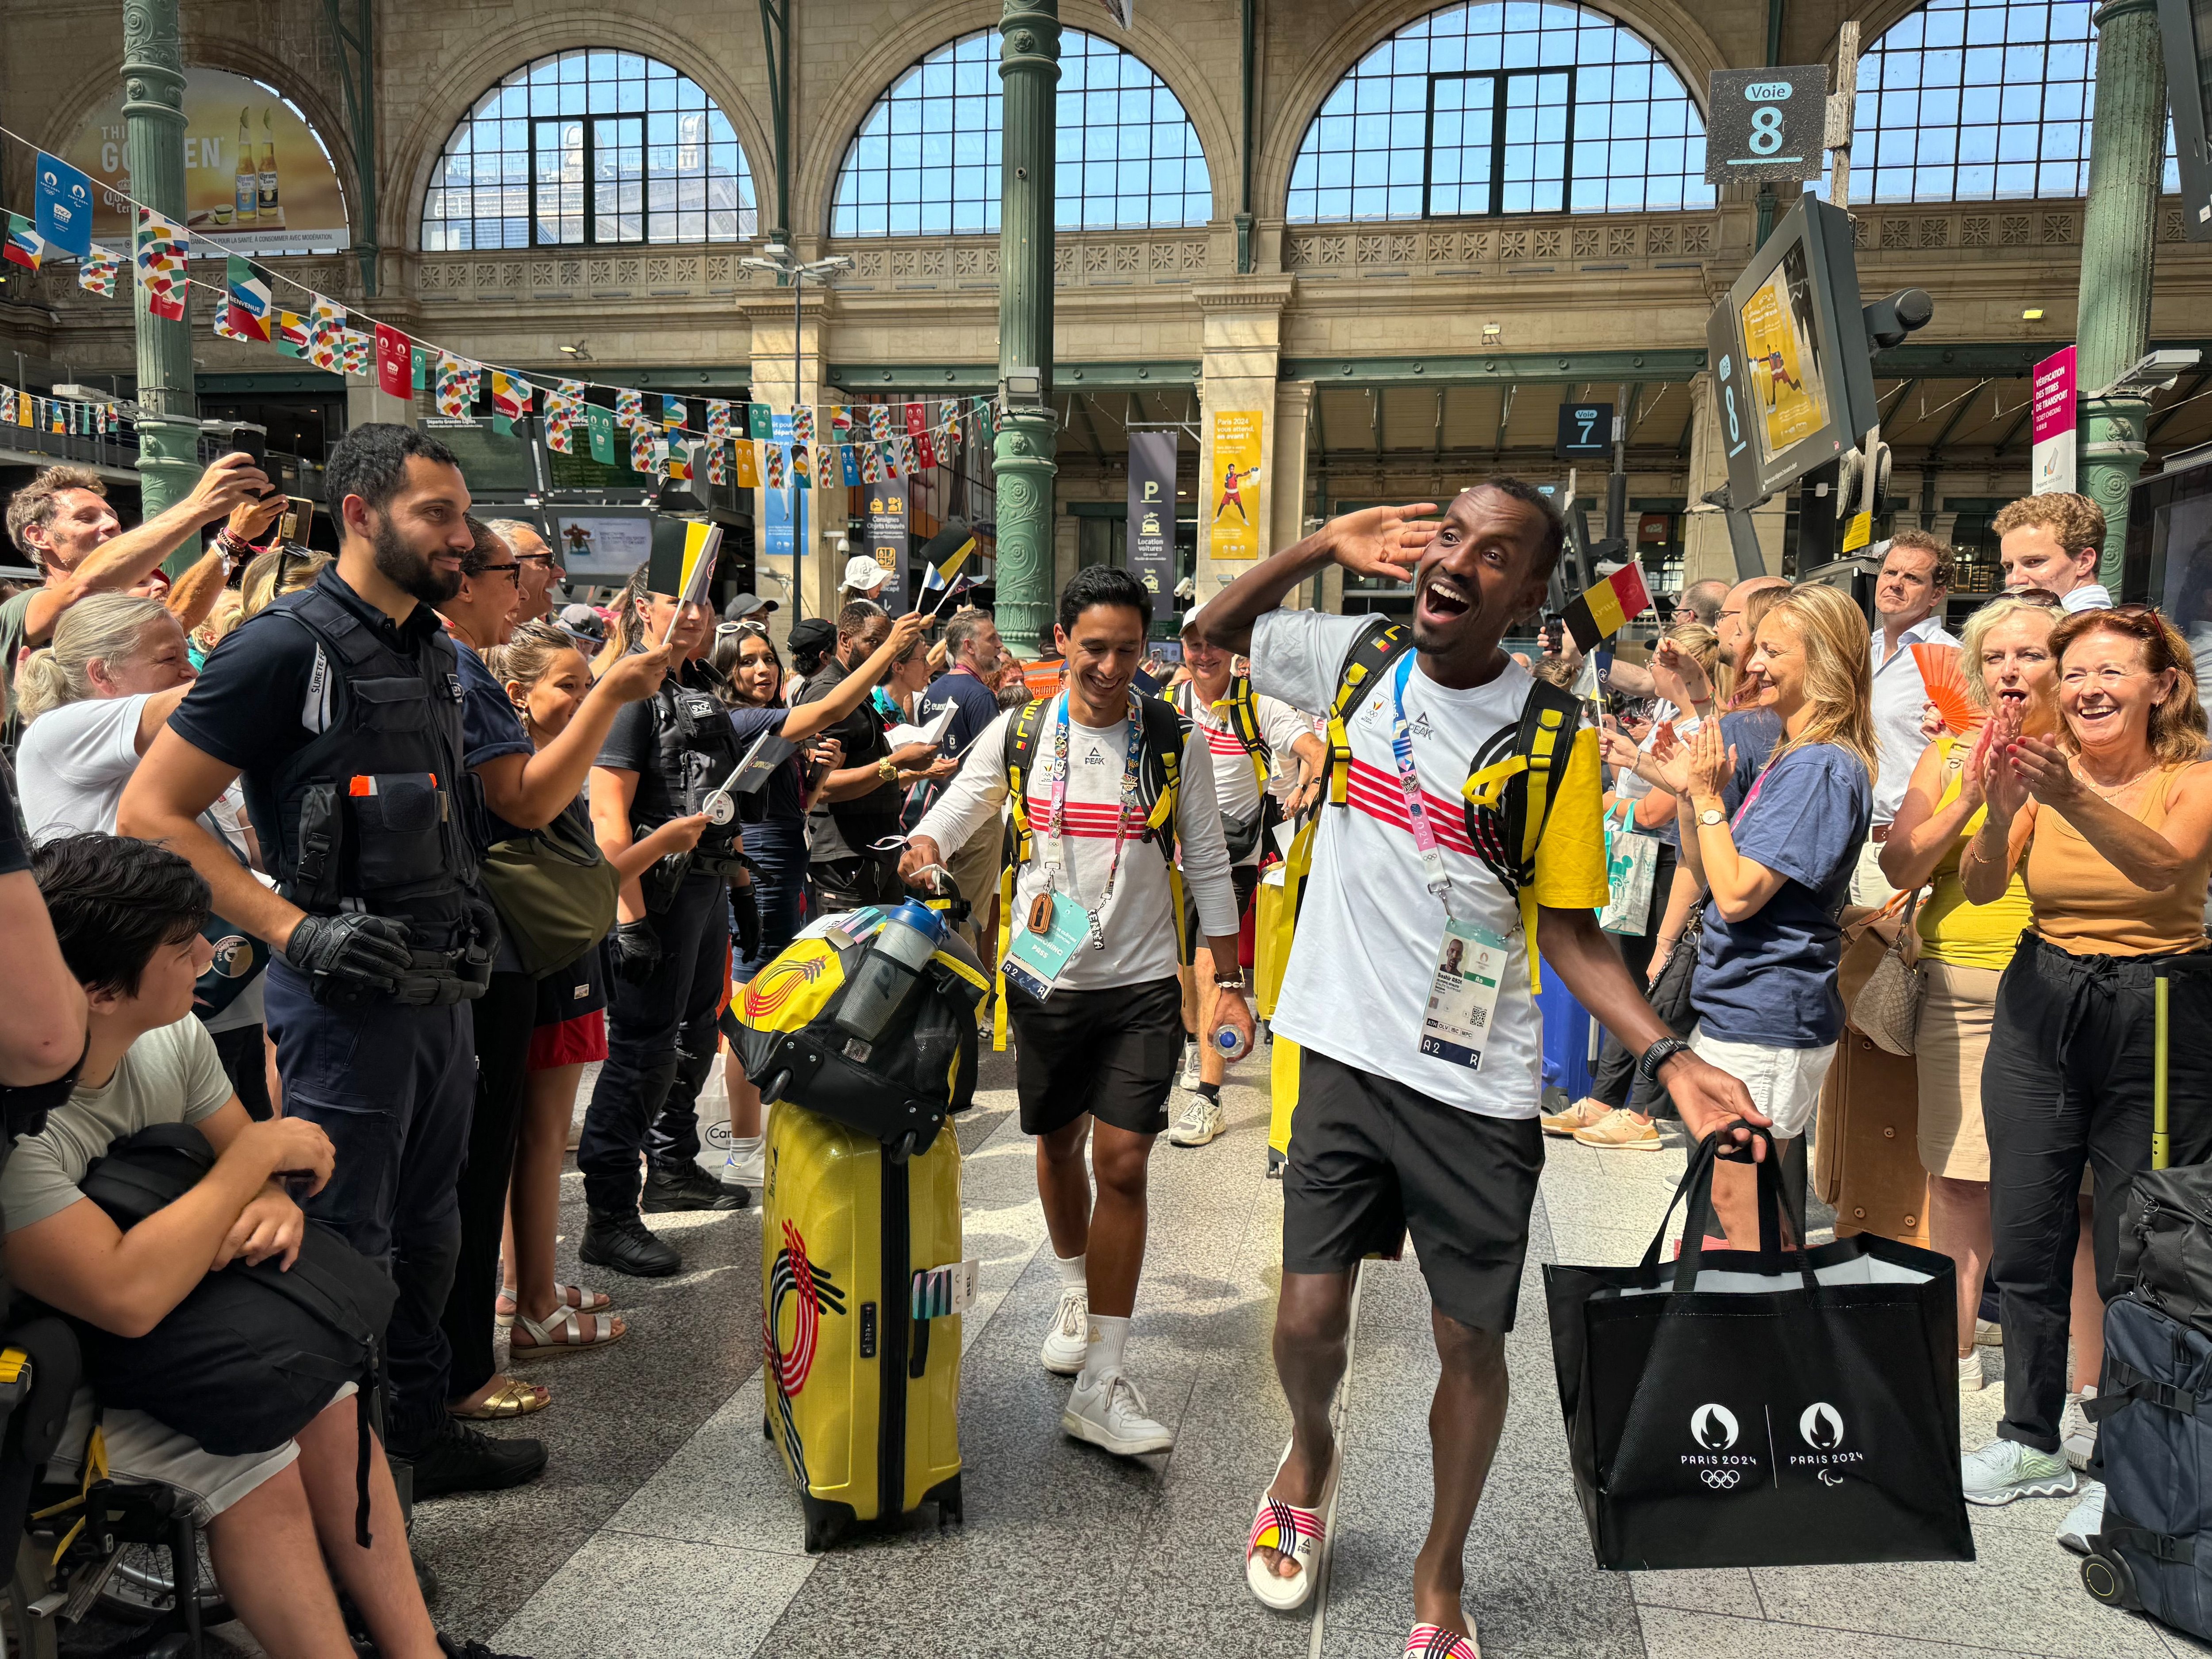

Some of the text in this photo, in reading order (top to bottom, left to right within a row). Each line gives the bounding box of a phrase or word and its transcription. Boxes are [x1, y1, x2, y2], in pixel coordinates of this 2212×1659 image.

[1751, 84, 1786, 99] Voie
[1749, 107, 1783, 155] 8
[8, 238, 34, 253] BIENVENUE
[229, 295, 261, 313] BIENVENUE
[282, 335, 304, 344] WELCOME
[2035, 365, 2066, 388] VÉRIFICATION
[2036, 381, 2059, 400] DES TITRES
[2036, 389, 2068, 412] DE TRANSPORT
[495, 406, 516, 417] WELCOME
[1726, 385, 1739, 442] 8
[1578, 421, 1594, 444] 7
[872, 515, 900, 524] Consignes
[311, 660, 324, 694] SURETE
[691, 703, 710, 713] SNCF
[1016, 698, 1045, 738] BEL
[1409, 722, 1434, 741] PEAK
[1085, 757, 1106, 766] PEAK
[1031, 944, 1049, 959] PASS
[1003, 963, 1045, 995] A 2 R
[1423, 1039, 1478, 1066] A 2 R
[710, 1128, 731, 1138] Car
[1681, 1455, 1757, 1465] PARIS 2024
[1790, 1452, 1863, 1465] PARIS 2024
